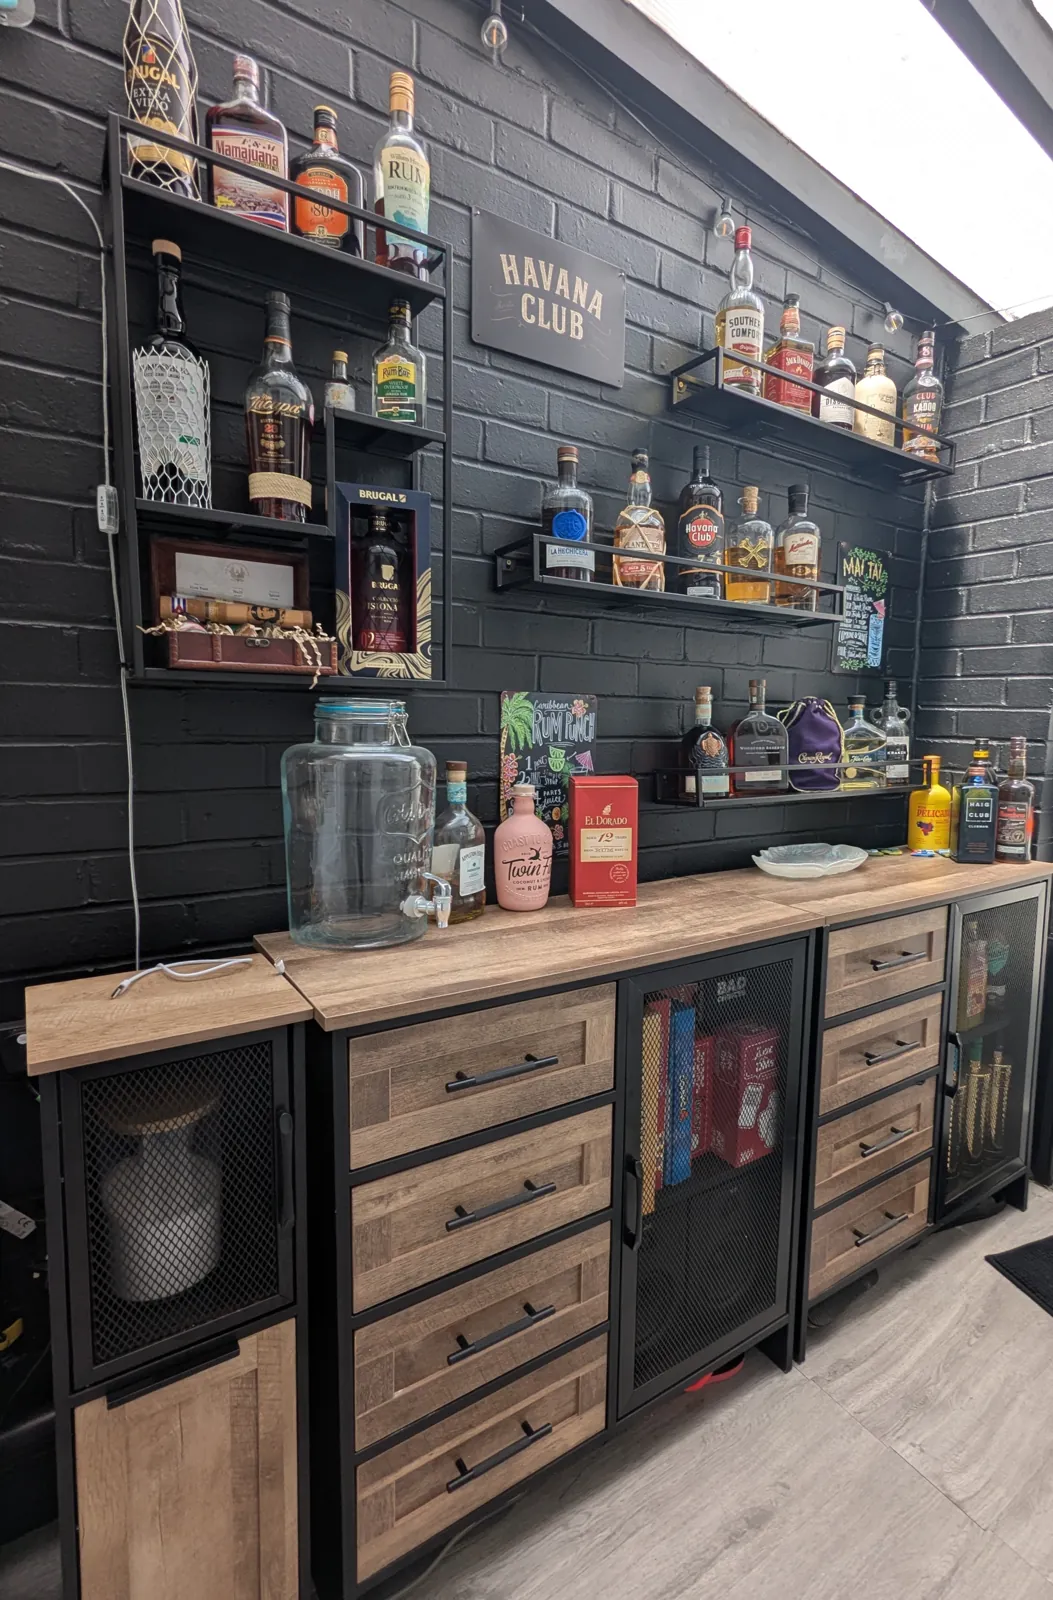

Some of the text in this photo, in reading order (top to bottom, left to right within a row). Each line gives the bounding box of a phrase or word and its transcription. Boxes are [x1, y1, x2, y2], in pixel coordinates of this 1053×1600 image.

[133, 87, 171, 103] EXTRA
[215, 140, 279, 167] Mamajuana
[499, 253, 604, 321] HAVANA
[520, 293, 585, 340] CLUB
[785, 356, 797, 366] JACK
[916, 392, 936, 400] CLUB
[359, 489, 399, 502] BRUGAL
[685, 524, 718, 534] Havana
[691, 532, 712, 542] Club
[551, 547, 589, 557] LA HECHICERA
[639, 563, 646, 572] 5
[843, 556, 883, 581] MAI TAI
[533, 699, 572, 710] Caribbean
[532, 709, 596, 747] RUM PUNCH
[543, 789, 562, 797] PARTS
[585, 815, 628, 827] EL DORADO
[598, 832, 614, 843] 12
[501, 858, 541, 881] Twin
[527, 884, 543, 892] RUM
